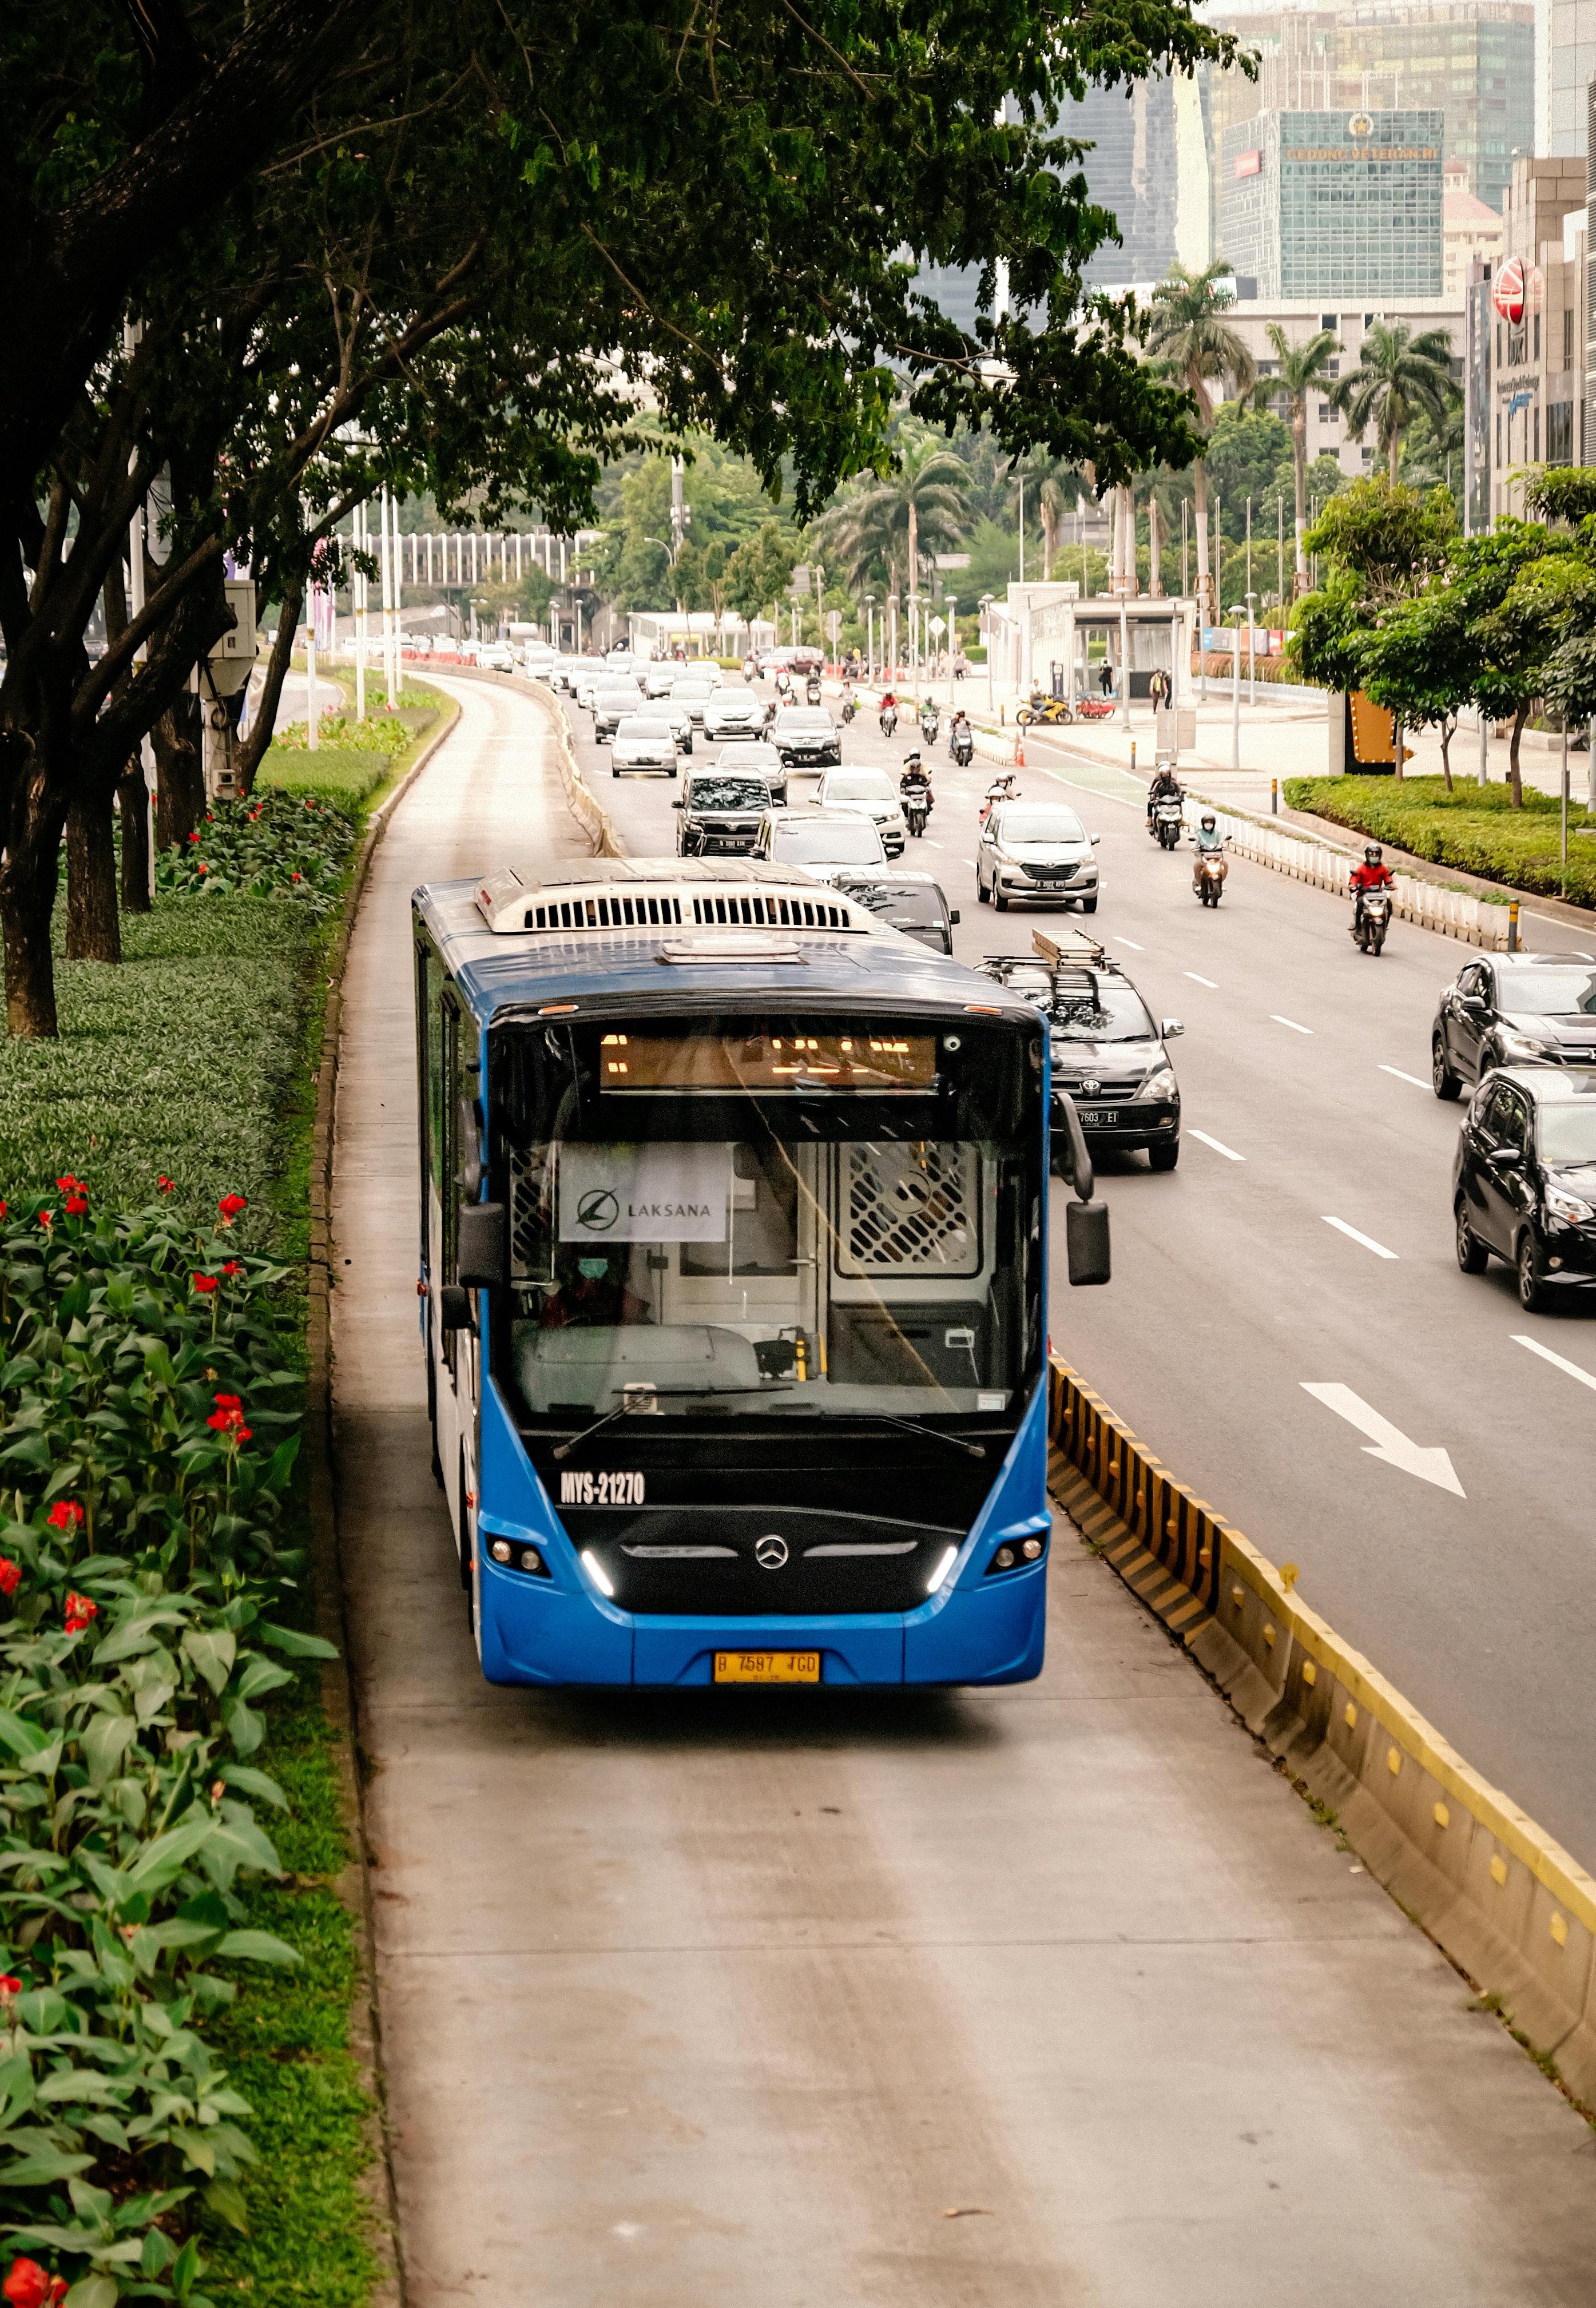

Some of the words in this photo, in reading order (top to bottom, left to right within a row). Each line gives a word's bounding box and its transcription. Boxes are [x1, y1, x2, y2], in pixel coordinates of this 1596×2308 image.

[1286, 148, 1347, 161] GEDUNG
[1351, 148, 1419, 160] VETERAN
[1422, 146, 1438, 159] RI
[1080, 1113, 1098, 1122] 7603
[1107, 1113, 1117, 1122] EI
[628, 1203, 711, 1217] LAKSANA
[561, 1471, 645, 1505] MYS-21270
[718, 1656, 727, 1672] B
[789, 1656, 816, 1672] TGD
